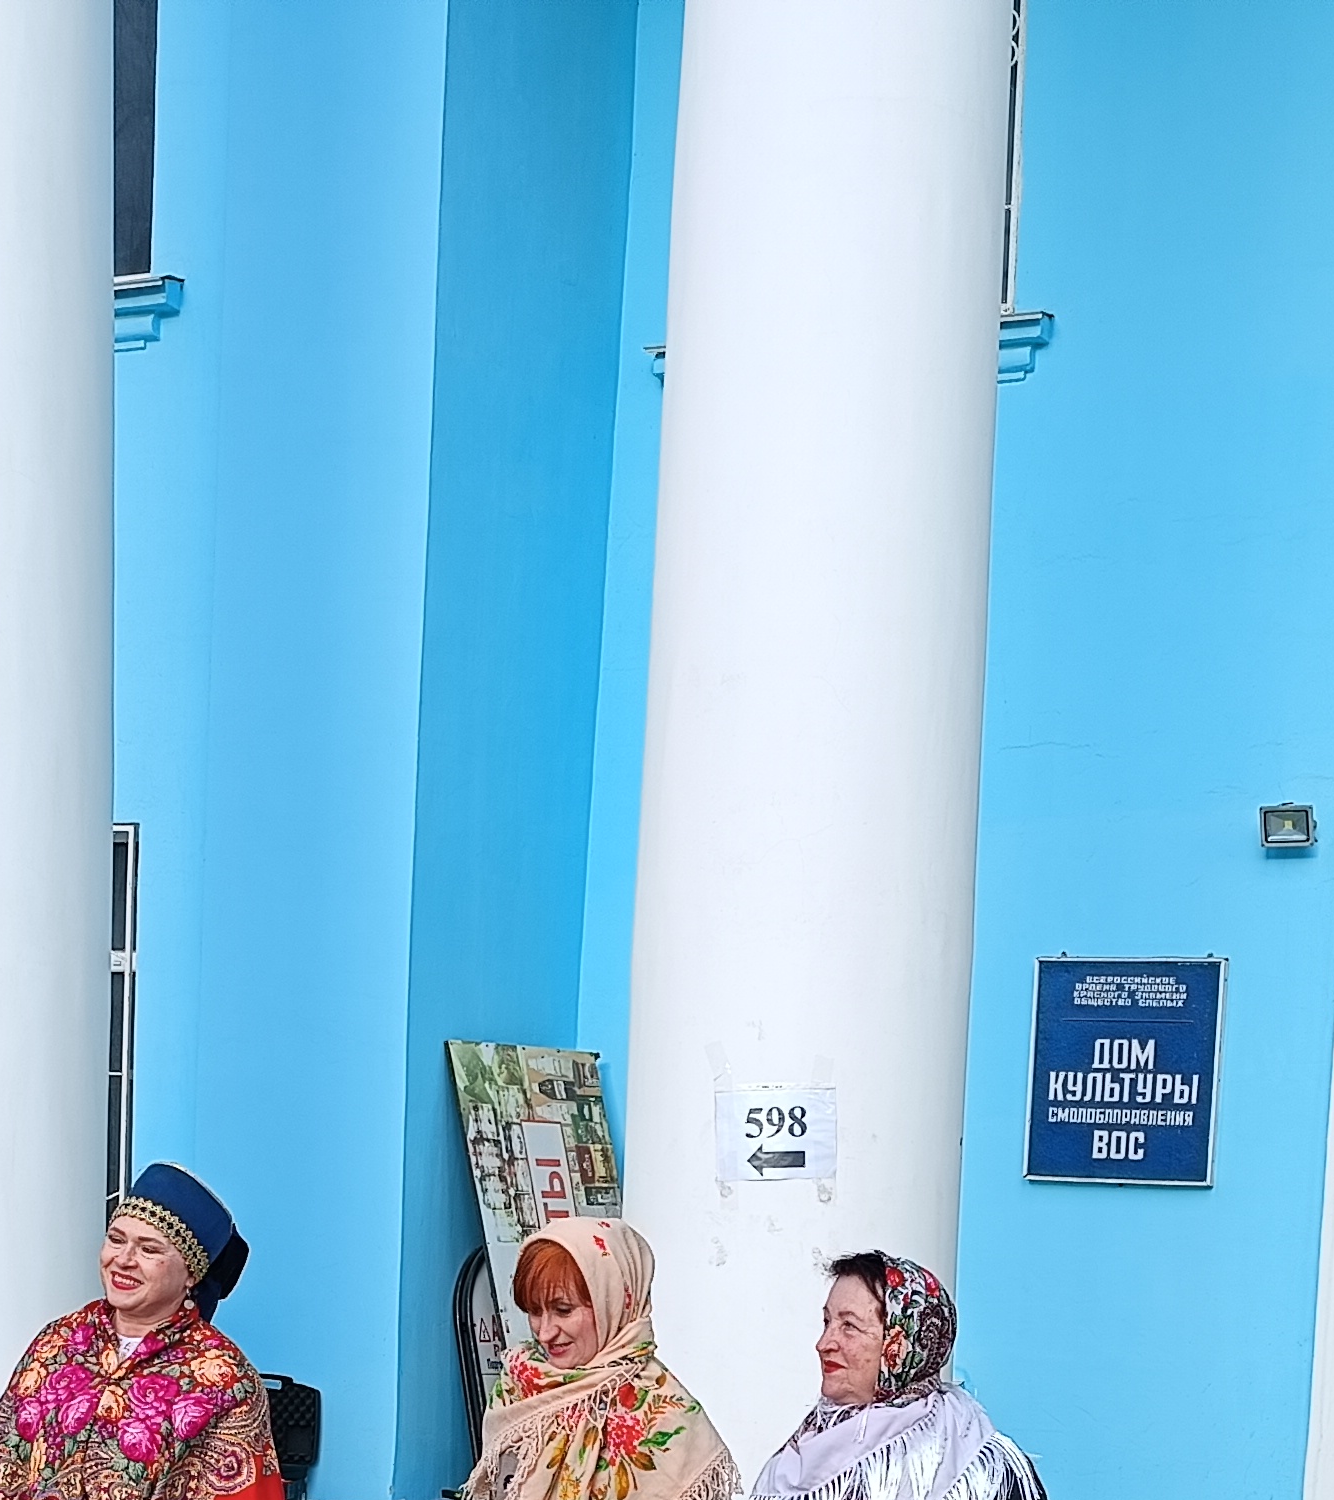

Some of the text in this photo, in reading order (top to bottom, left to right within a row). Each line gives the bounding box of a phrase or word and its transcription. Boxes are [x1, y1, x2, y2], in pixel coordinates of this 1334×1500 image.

[1091, 1038, 1156, 1070] ДОМ
[1047, 1071, 1200, 1105] КУЛЬТУРЫ
[744, 1105, 808, 1139] 598
[1047, 1106, 1194, 1127] СМОЛОБЛПРАВЛЕНИЯ
[1091, 1129, 1145, 1160] ВОС
[535, 1158, 571, 1224] ТЫ
